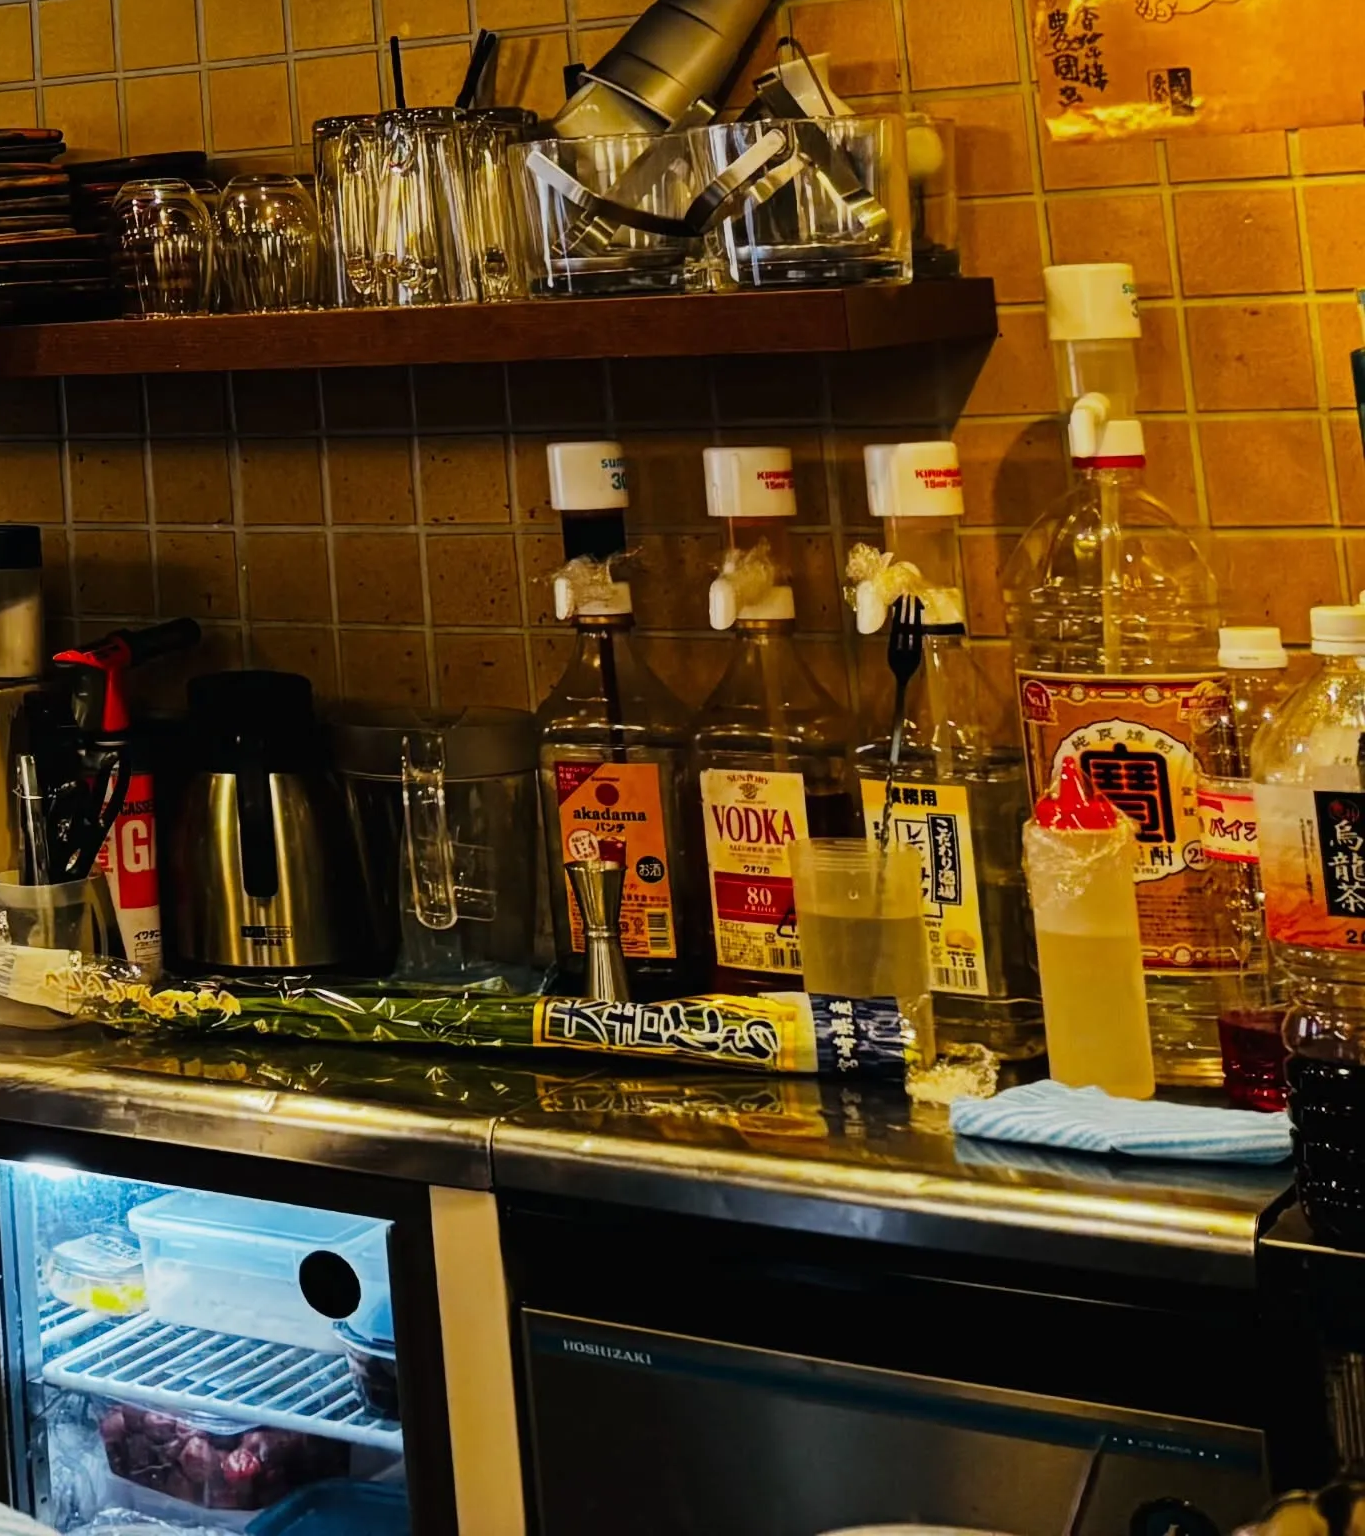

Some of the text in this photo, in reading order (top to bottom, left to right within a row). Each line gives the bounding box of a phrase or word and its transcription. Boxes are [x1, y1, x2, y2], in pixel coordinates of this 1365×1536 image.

[726, 774, 770, 785] SUNTORY
[572, 806, 647, 822] akadama
[595, 821, 626, 833] パンチ
[711, 804, 797, 846] VODKA
[638, 863, 662, 878] お酒
[1329, 819, 1365, 913] 烏龍茶
[746, 886, 773, 906] 80
[949, 955, 975, 969] 1:5
[562, 1338, 653, 1366] HOSHIZAKI
